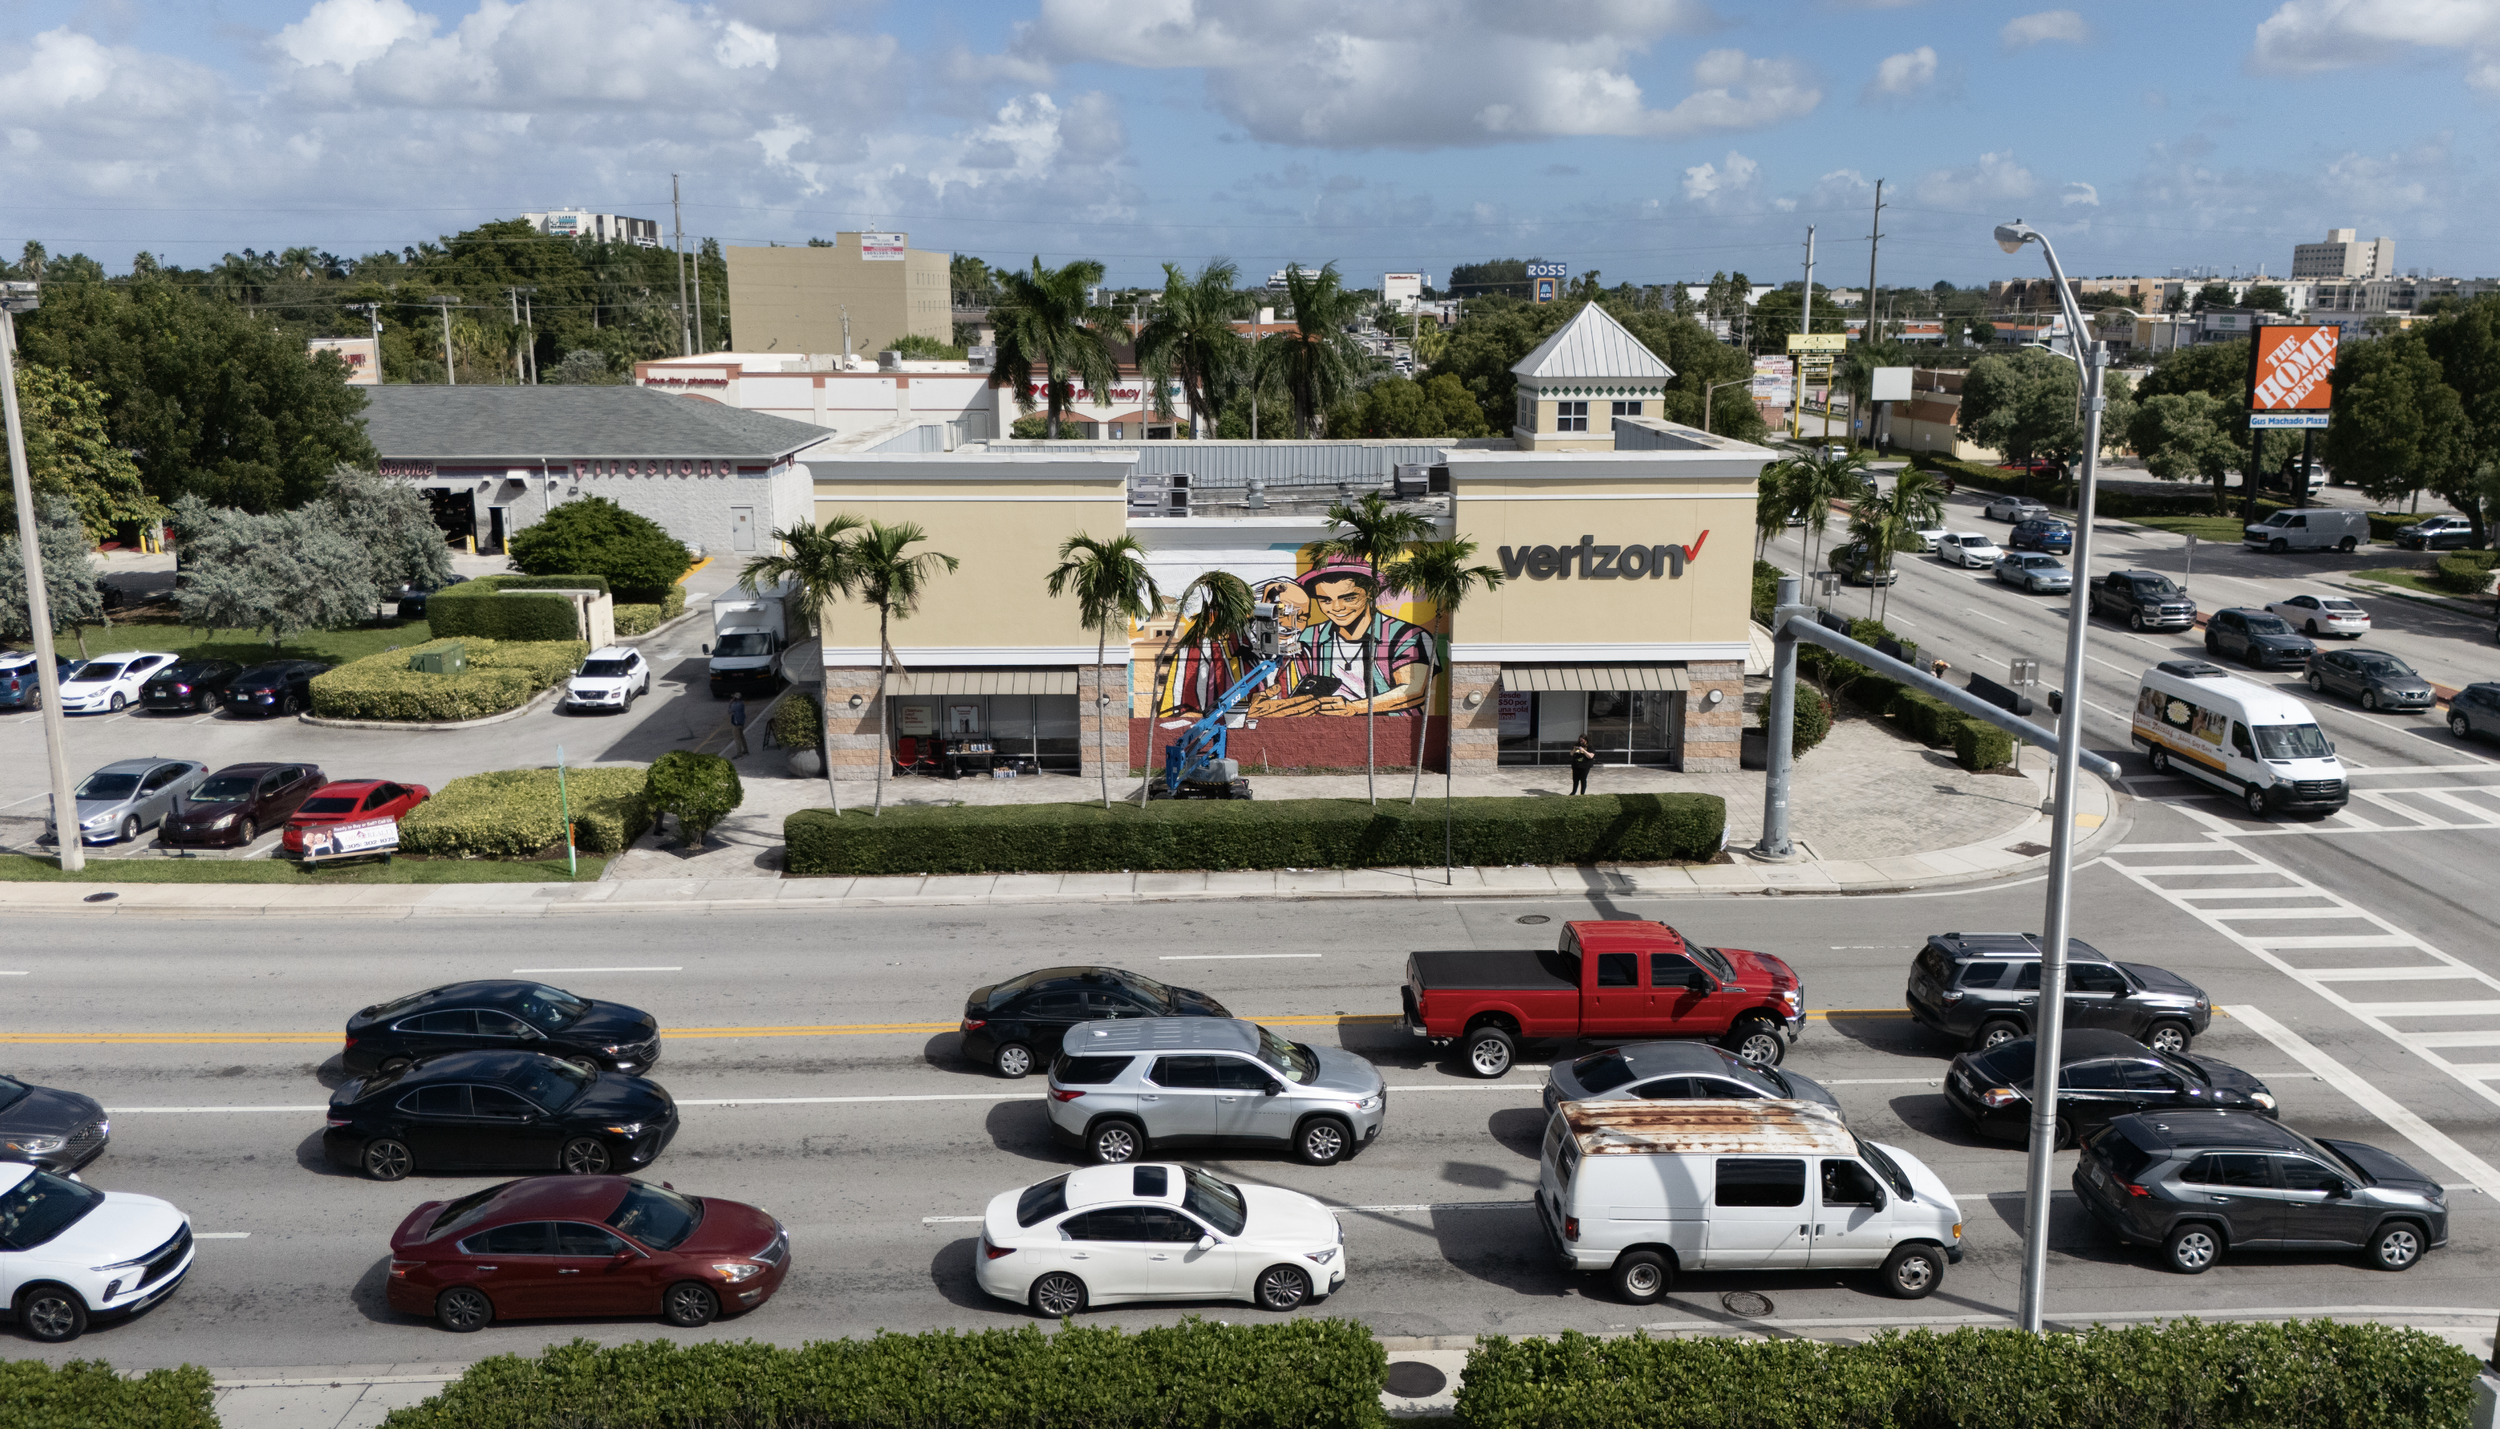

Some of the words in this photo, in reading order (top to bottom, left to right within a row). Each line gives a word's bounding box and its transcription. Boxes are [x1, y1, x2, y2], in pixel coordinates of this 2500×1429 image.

[1528, 265, 1566, 276] ROSS
[2265, 334, 2301, 368] THE
[2254, 326, 2339, 409] HOME
[688, 377, 730, 387] pharmacy
[1041, 384, 1076, 398] CS
[2283, 356, 2336, 409] DEPOT
[2251, 417, 2266, 426] Gus
[2268, 417, 2304, 426] Machado
[2306, 417, 2328, 426] Plaza
[379, 460, 434, 477] Service
[572, 459, 732, 480] Firestone
[1498, 534, 1686, 579] verizon
